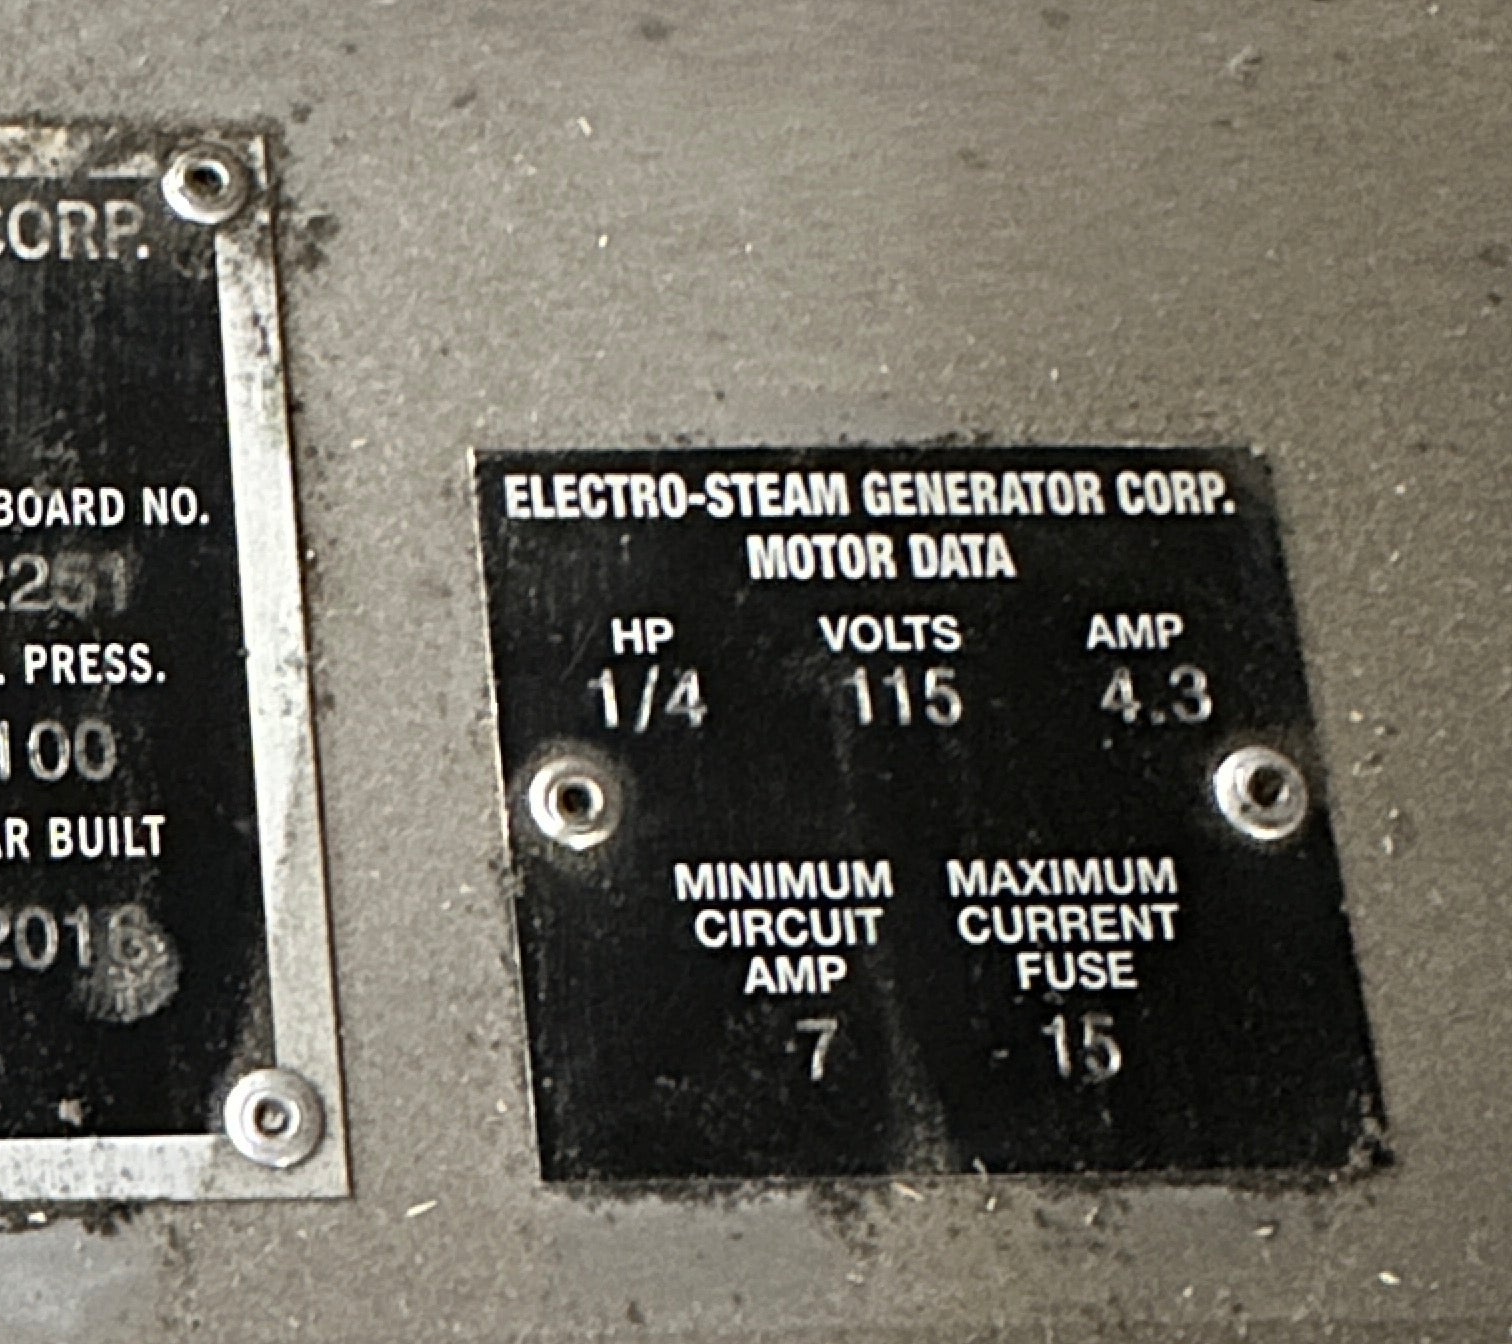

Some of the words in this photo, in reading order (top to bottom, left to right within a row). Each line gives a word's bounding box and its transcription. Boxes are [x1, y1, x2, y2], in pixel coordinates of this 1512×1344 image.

[143, 487, 210, 524] NO.
[504, 472, 849, 519] ELECTRO-STEAM
[862, 471, 1105, 515] GENERATOR
[1116, 471, 1236, 514] CORP.
[748, 534, 897, 580] MOTOR
[911, 533, 1016, 578] DATA
[611, 618, 674, 653] HP
[819, 616, 962, 652] VOLTS
[1087, 614, 1184, 649] AMP
[25, 643, 166, 684] PRESS.
[587, 667, 708, 732] 1/4
[844, 665, 963, 726] 115
[1101, 665, 1213, 726] 4.3
[49, 815, 165, 858] BUILT
[674, 861, 894, 901] MINIMUM
[947, 858, 1178, 897] MAXIMUM
[694, 907, 883, 947] CIRCUIT
[958, 904, 1180, 942] CURRENT
[745, 955, 847, 995] AMP
[1016, 951, 1138, 990] FUSE
[795, 1018, 838, 1081] 7
[1041, 1015, 1122, 1080] 15
